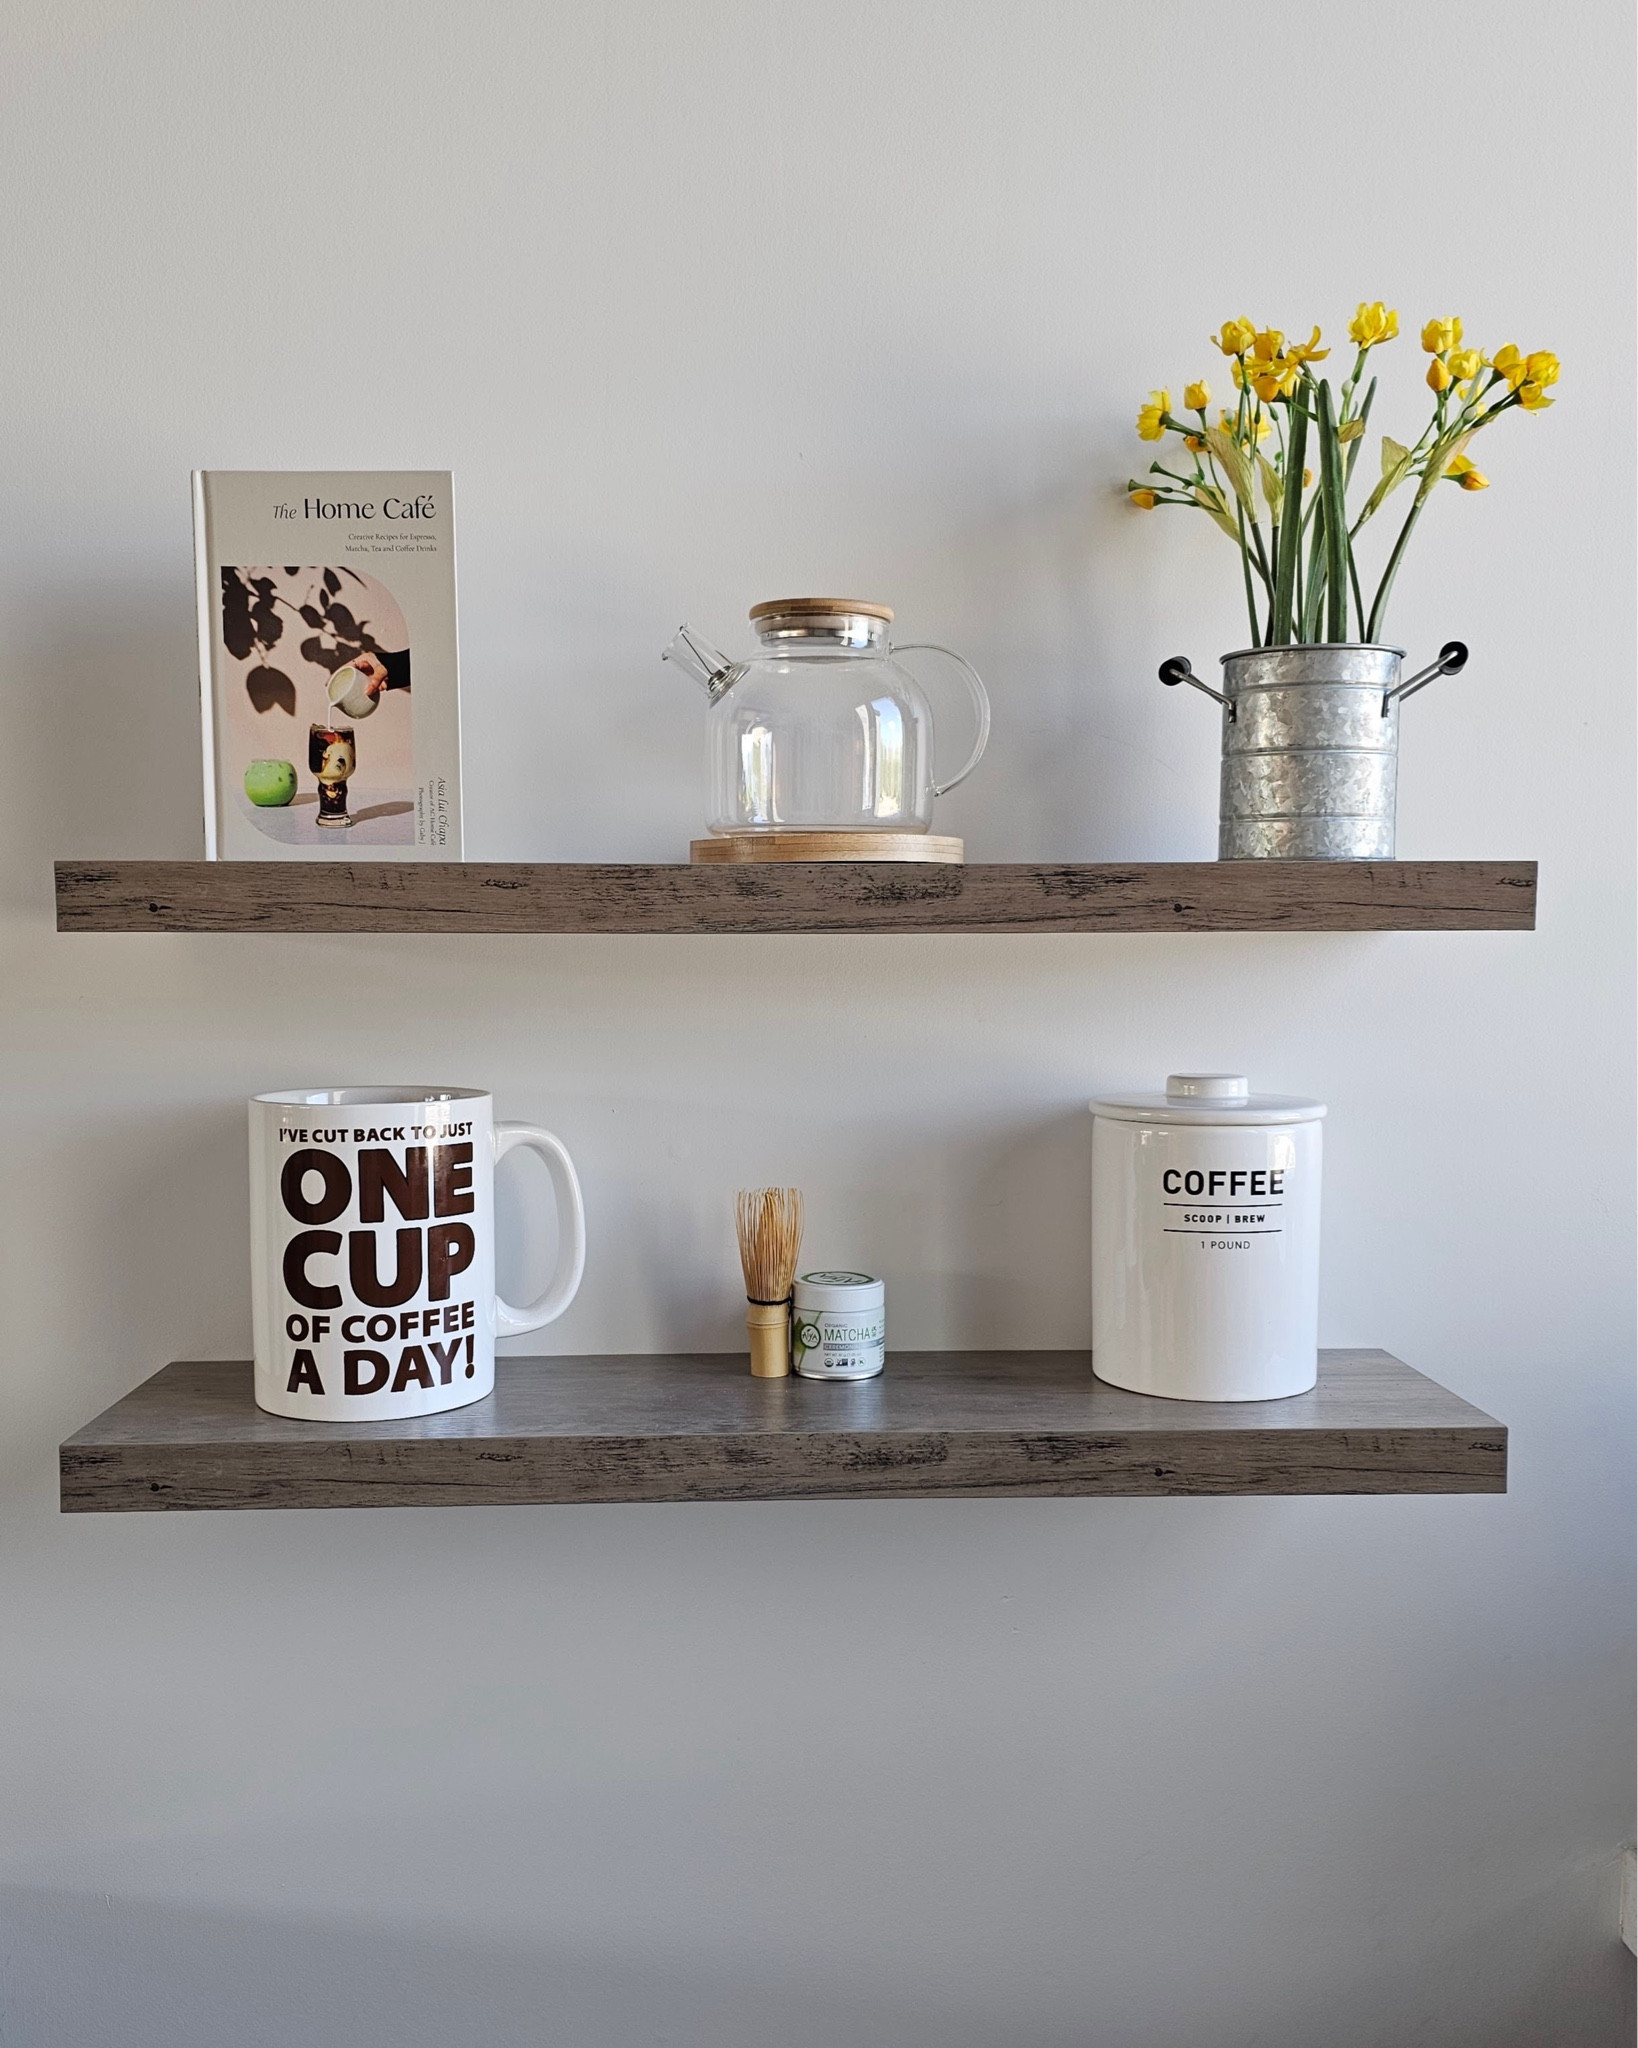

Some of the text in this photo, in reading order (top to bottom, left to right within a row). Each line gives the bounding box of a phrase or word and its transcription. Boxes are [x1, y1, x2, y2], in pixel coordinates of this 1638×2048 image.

[273, 495, 437, 520] The Home Café
[348, 533, 437, 542] Creative Recipes for Espresso,
[345, 545, 370, 553] Matcha,
[438, 777, 448, 796] Asia
[279, 1122, 473, 1143] I'VE CUT BACK TO JUST
[280, 1142, 475, 1225] ONE
[1163, 1169, 1284, 1196] COFFEE
[1184, 1214, 1222, 1223] SCOOP
[1235, 1214, 1265, 1223] BREW
[1200, 1240, 1251, 1250] 1 POUND
[282, 1222, 475, 1309] CUP
[285, 1301, 475, 1343] OF COFFEE
[824, 1328, 870, 1341] MATCHA
[286, 1334, 475, 1396] A DAY!
